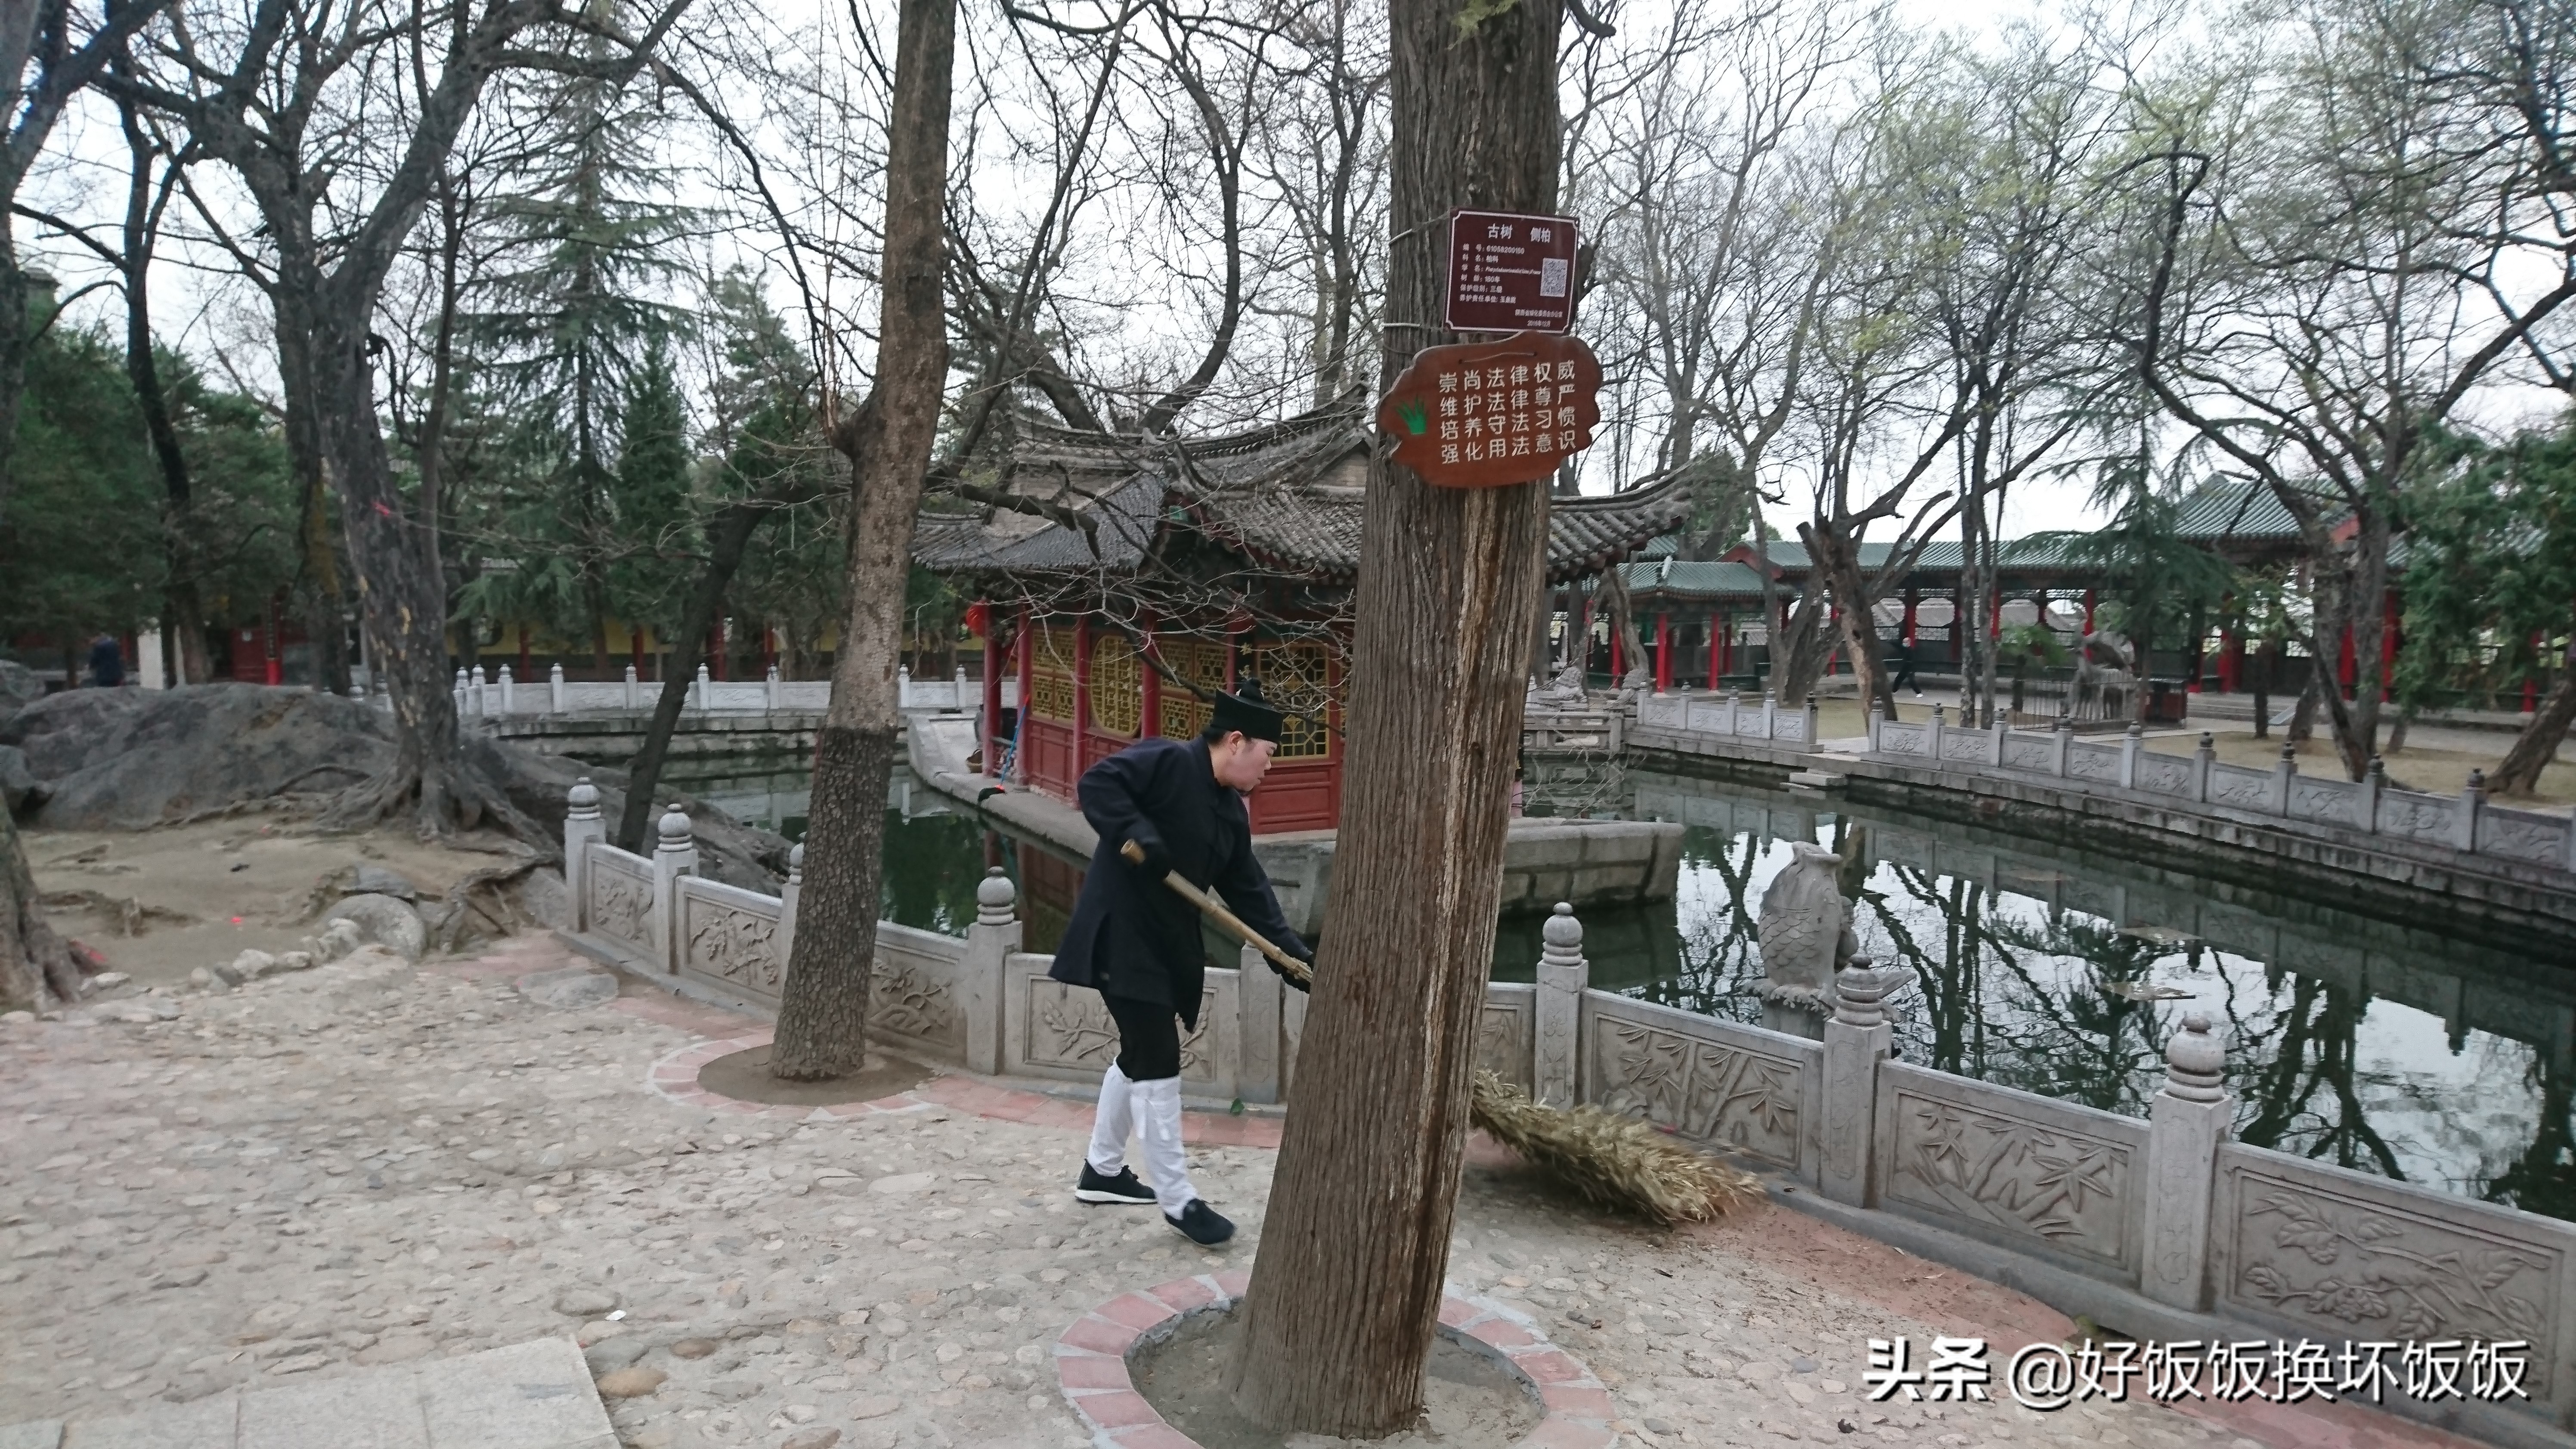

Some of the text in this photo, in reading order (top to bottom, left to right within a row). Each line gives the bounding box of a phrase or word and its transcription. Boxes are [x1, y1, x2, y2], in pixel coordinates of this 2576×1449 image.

[1487, 223, 1551, 243] 古树 侧柏
[1439, 359, 1575, 393] 崇尚法律权威
[1440, 384, 1576, 418] 维护法律尊严
[1440, 406, 1576, 440] 培养守法习惯
[1441, 430, 1576, 465] 强化用法意识
